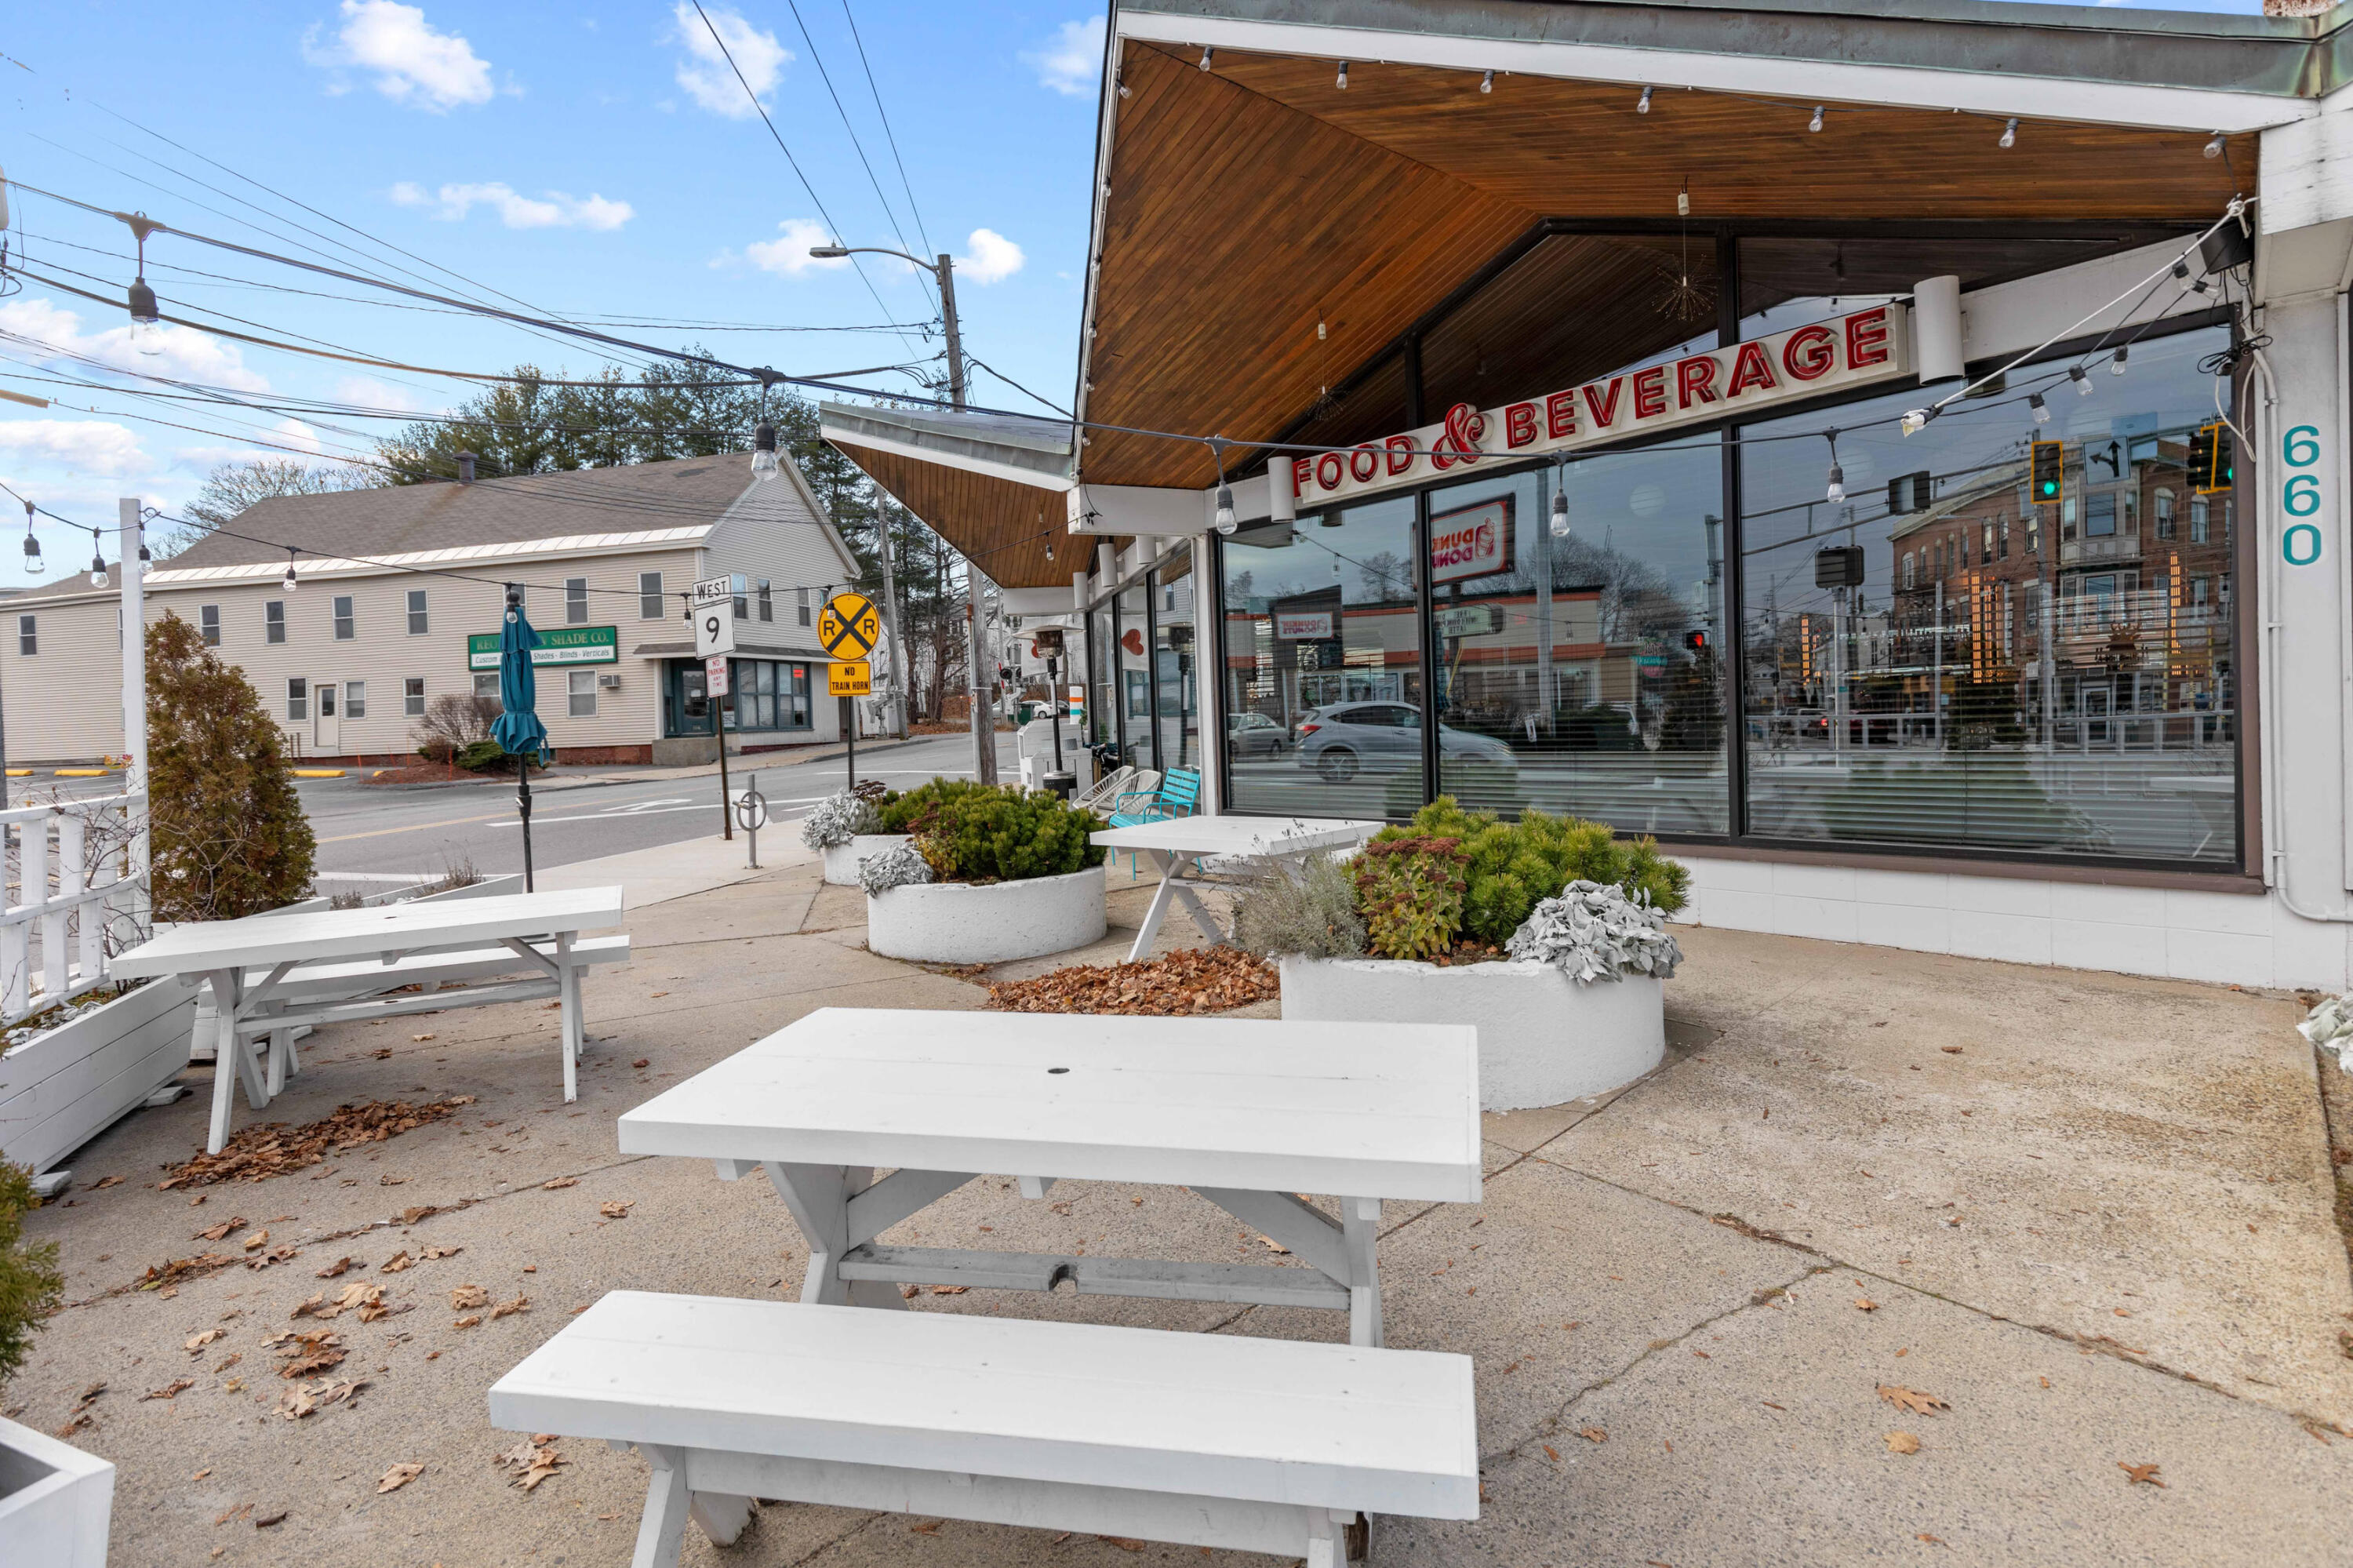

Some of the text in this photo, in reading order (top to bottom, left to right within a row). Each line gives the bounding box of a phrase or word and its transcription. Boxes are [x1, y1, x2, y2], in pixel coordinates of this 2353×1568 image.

[1293, 307, 1889, 498] FOOD & BEVERAGE
[2283, 425, 2322, 566] 660
[696, 580, 727, 600] WEST
[706, 616, 719, 644] 9
[551, 632, 588, 646] SHADE
[591, 631, 609, 643] CO.
[475, 648, 609, 664] Custom Shades Blinds Verticals
[707, 667, 726, 676] PARKING
[845, 667, 855, 676] NO
[831, 681, 868, 691] TRAIN HORN
